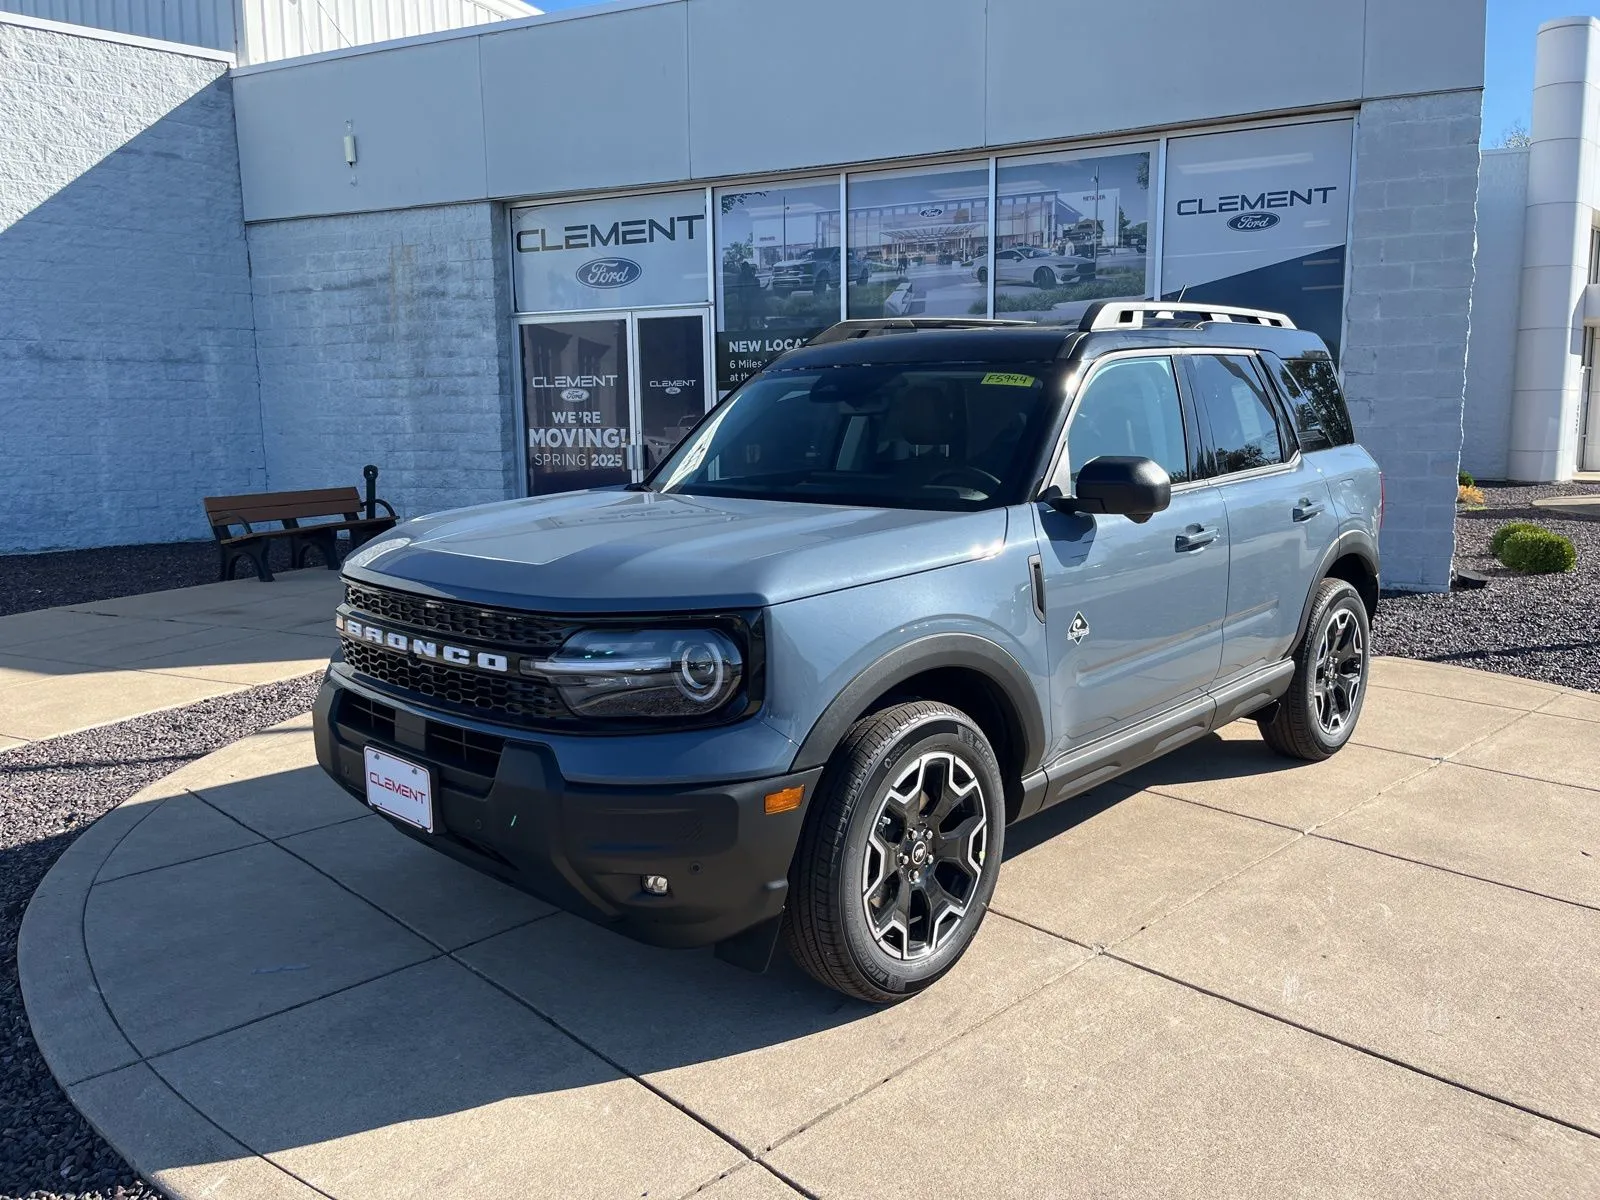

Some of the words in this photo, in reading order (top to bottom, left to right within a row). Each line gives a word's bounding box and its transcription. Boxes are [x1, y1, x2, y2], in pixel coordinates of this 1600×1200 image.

[1177, 186, 1337, 216] CLEMENT
[1237, 215, 1269, 229] Ford
[516, 214, 705, 253] CLEMENT
[587, 262, 629, 284] Ford
[729, 340, 762, 353] NEW
[729, 360, 736, 369] 6
[738, 359, 763, 369] Miles
[532, 374, 618, 388] CLEMENT
[649, 379, 696, 388] CLEMENT
[729, 373, 739, 382] at
[566, 390, 584, 400] Ford
[552, 411, 601, 424] WE'RE
[529, 428, 626, 448] MOVING!
[535, 453, 586, 466] SPRING
[591, 453, 622, 467] 2025
[347, 619, 508, 672] BRONCO
[369, 771, 426, 804] CLEMENT
